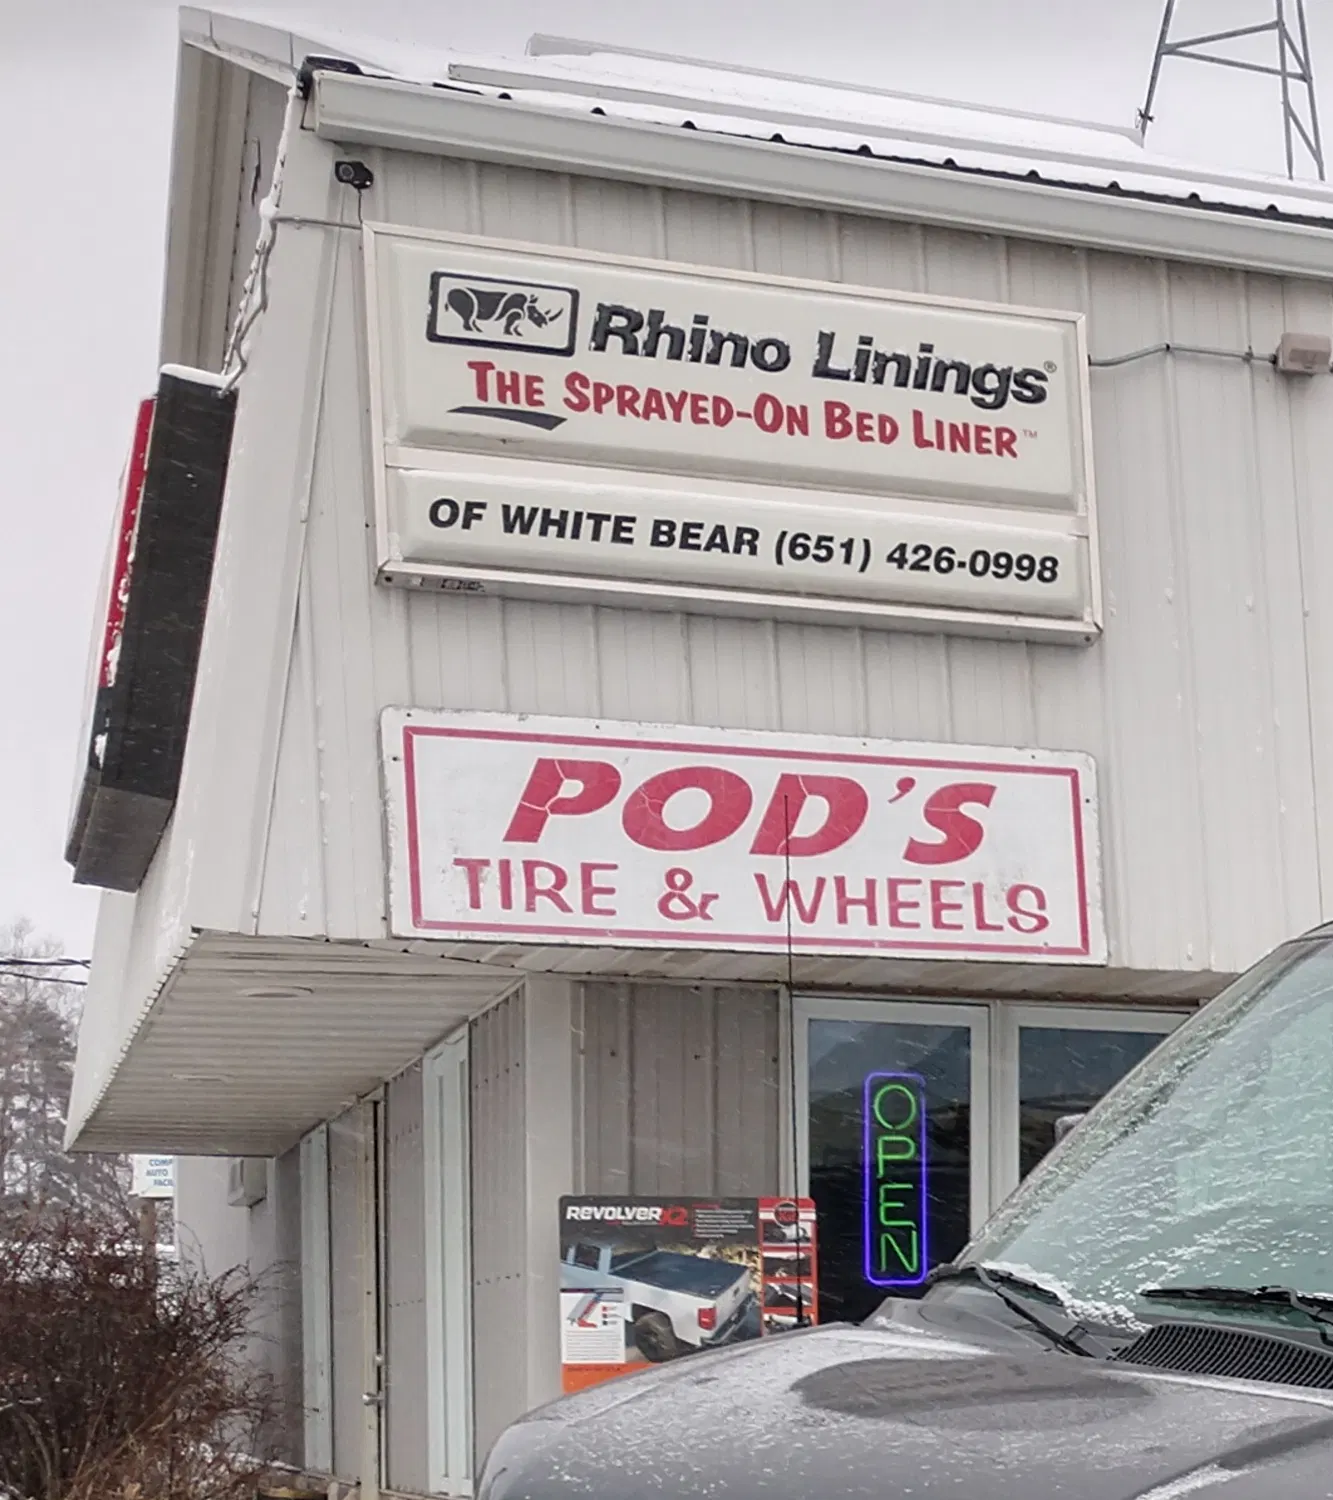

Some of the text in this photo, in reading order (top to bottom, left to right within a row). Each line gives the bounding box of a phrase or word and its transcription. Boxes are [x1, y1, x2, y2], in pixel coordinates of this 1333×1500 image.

[590, 302, 791, 373] Rhino
[467, 360, 545, 407] THE
[563, 371, 810, 436] SPRAYED-ON
[825, 406, 900, 446] BED
[428, 498, 1059, 584] OF WHITE BEAR (651) 426-0998
[502, 757, 997, 865] POD'S
[453, 857, 1049, 933] TIRE & WHEELS
[874, 1084, 918, 1272] OPEN
